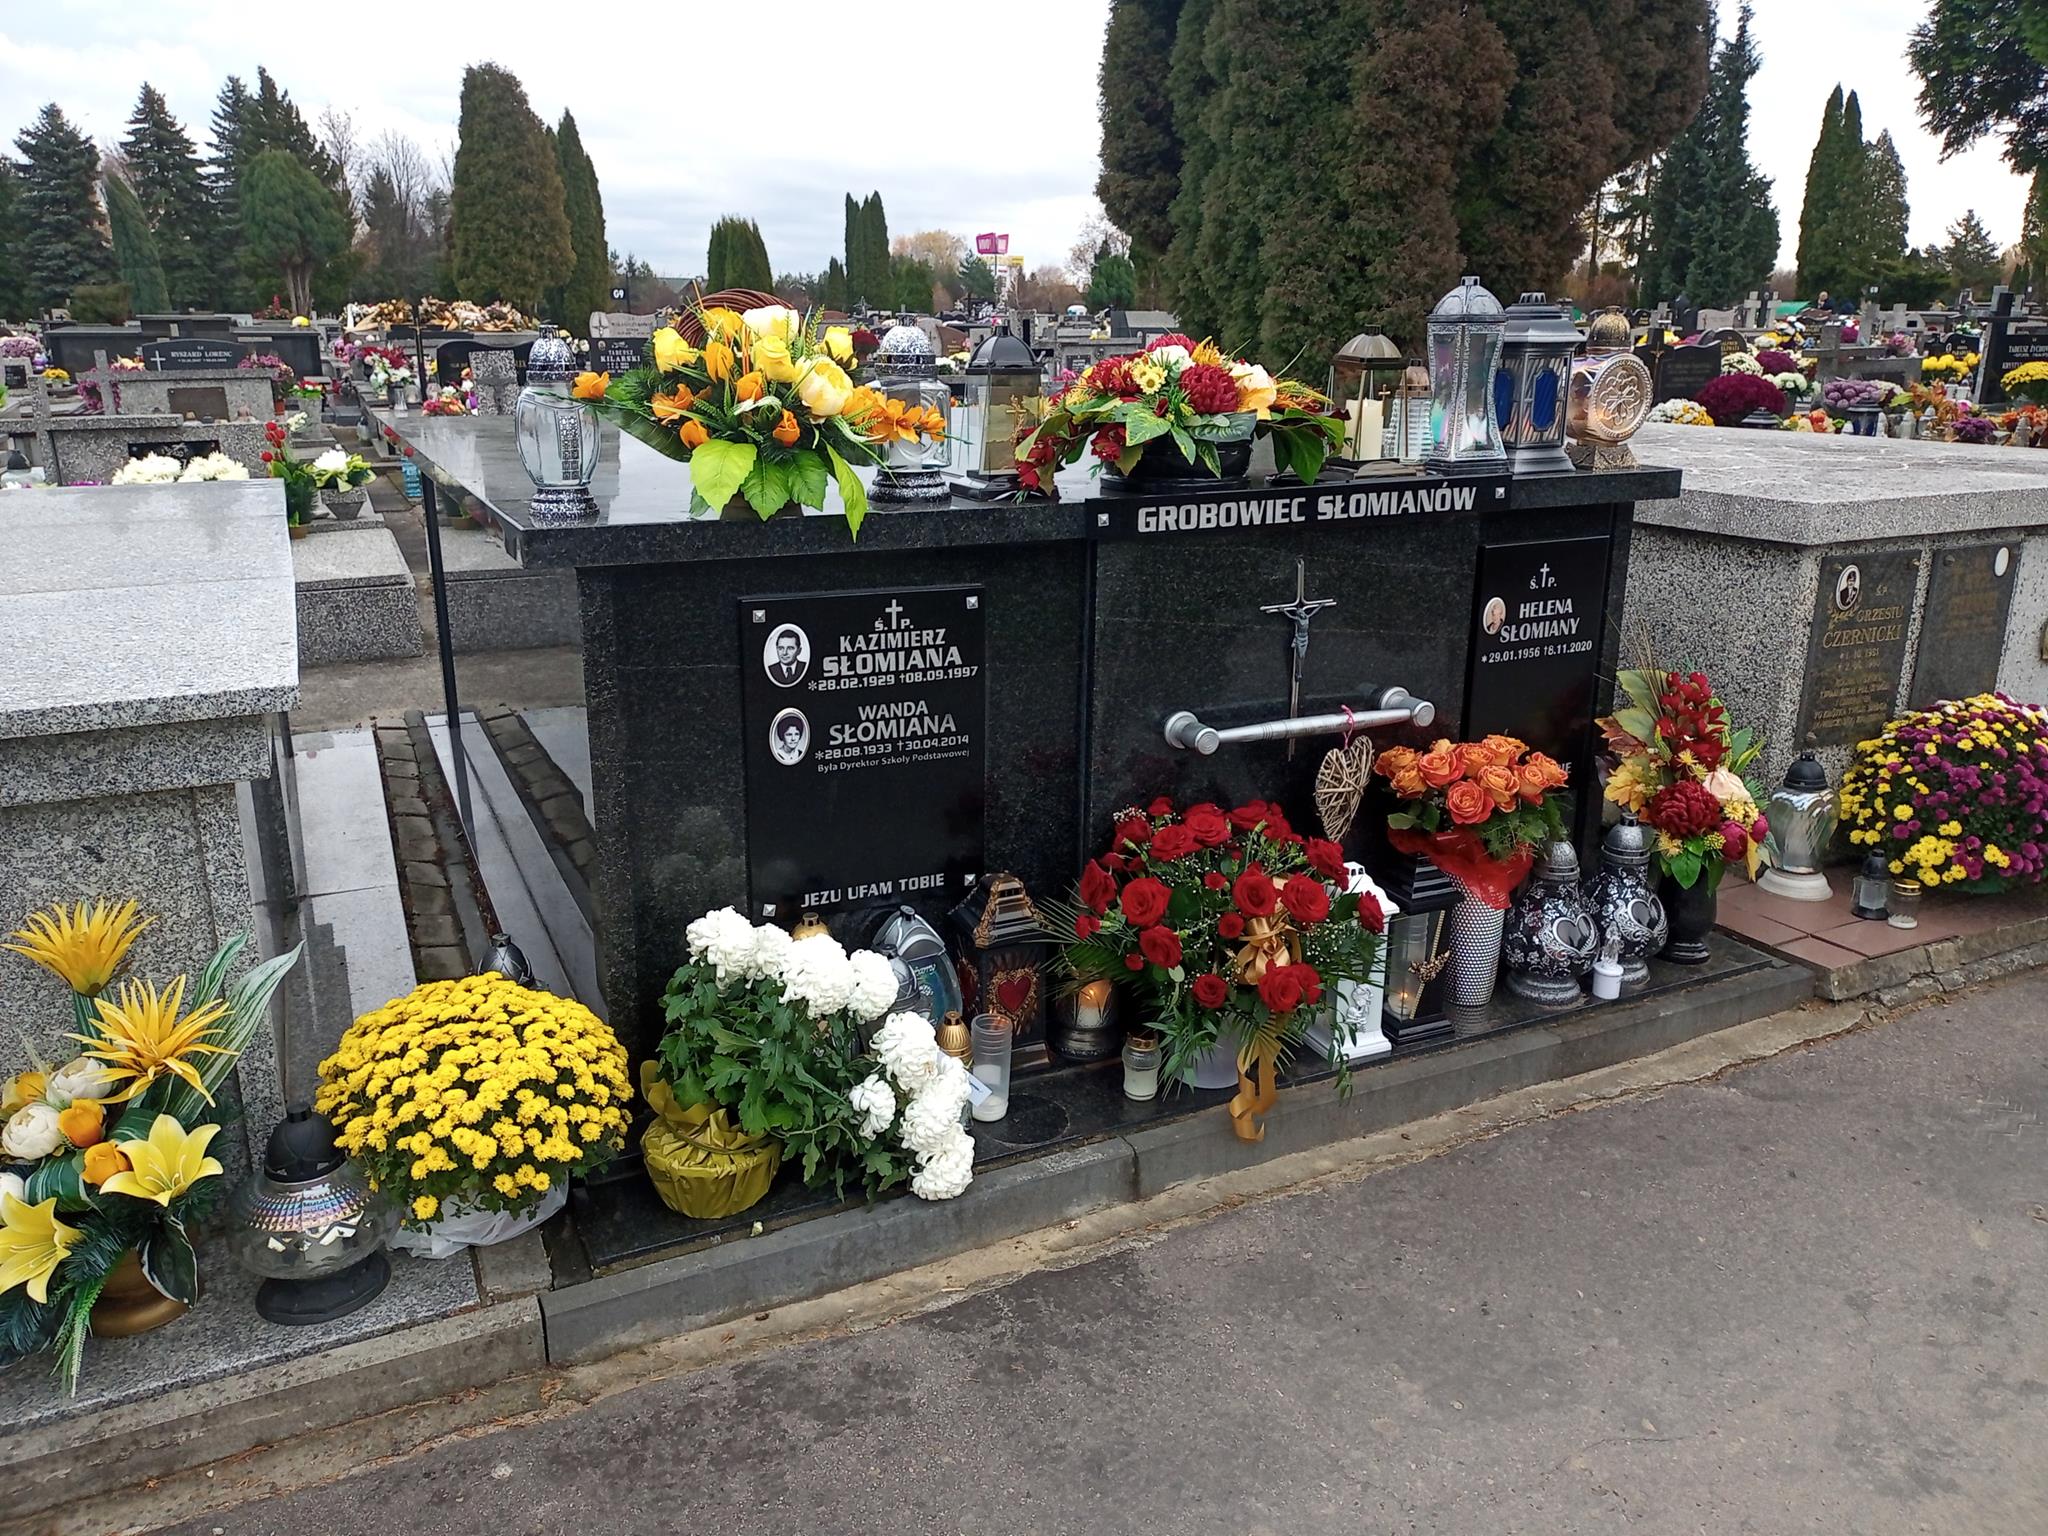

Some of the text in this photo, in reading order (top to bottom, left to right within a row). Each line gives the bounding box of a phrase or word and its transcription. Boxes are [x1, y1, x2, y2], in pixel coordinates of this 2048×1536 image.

[1137, 481, 1477, 533] GROBOWIEC SŁOMIANÓW
[1519, 598, 1573, 619] HELENA
[839, 628, 946, 653] KAZIMIERZ
[1500, 617, 1580, 643] SŁOMIANY
[1822, 624, 1903, 649] CZERNICKI
[822, 646, 963, 678] SŁOMIANA
[858, 700, 929, 721] WANDA
[829, 713, 957, 746] SŁOMIANA
[817, 760, 838, 774] Była
[839, 757, 880, 772] Dyrektor
[800, 872, 944, 908] JEZU UFAM TOBIE
